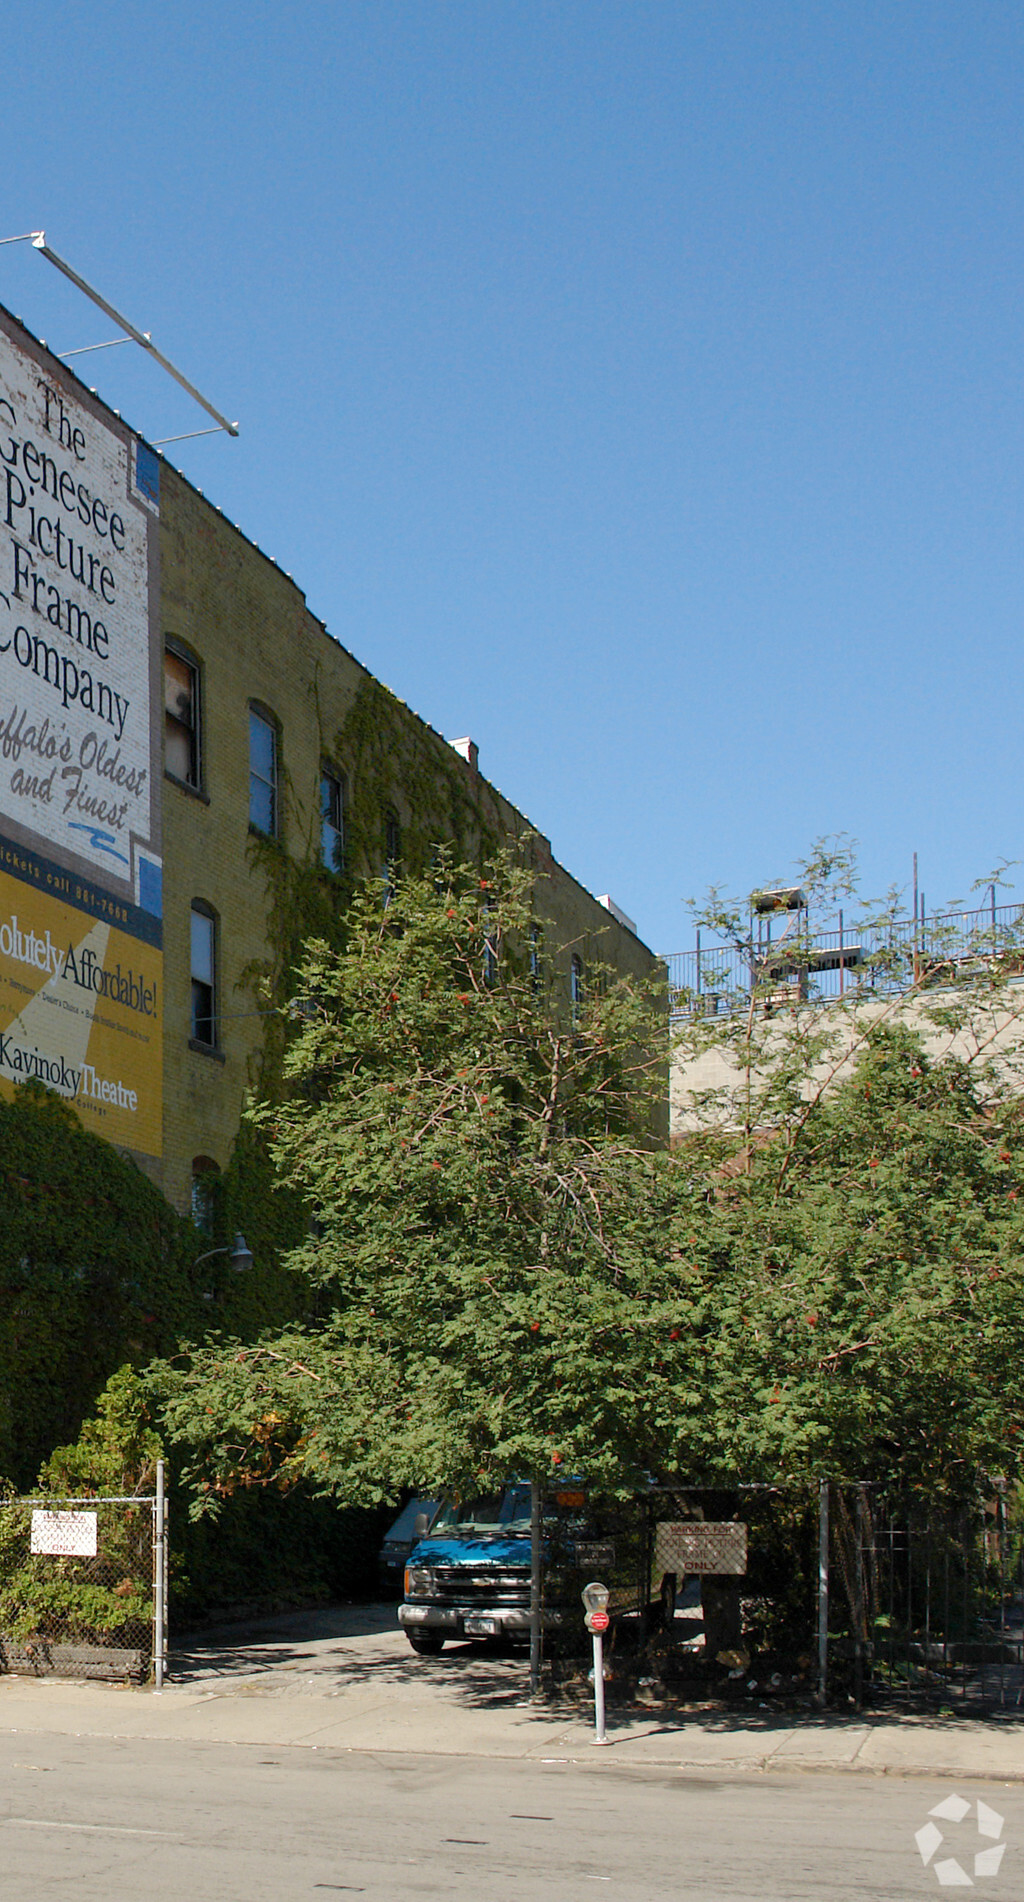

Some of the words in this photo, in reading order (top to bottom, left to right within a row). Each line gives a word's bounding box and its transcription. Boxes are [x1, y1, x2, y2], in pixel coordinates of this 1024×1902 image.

[37, 380, 86, 461] The
[3, 466, 116, 605] Picture
[10, 538, 109, 660] Frame
[79, 732, 146, 796] Oldest
[10, 766, 57, 803] and
[61, 766, 128, 830] Finest
[46, 873, 70, 893] call
[61, 943, 157, 1018] Affordable!
[79, 1062, 137, 1112] Theatre
[670, 1525, 709, 1534] PARKING
[713, 1525, 732, 1533] FOR
[684, 1561, 718, 1570] ONLY
